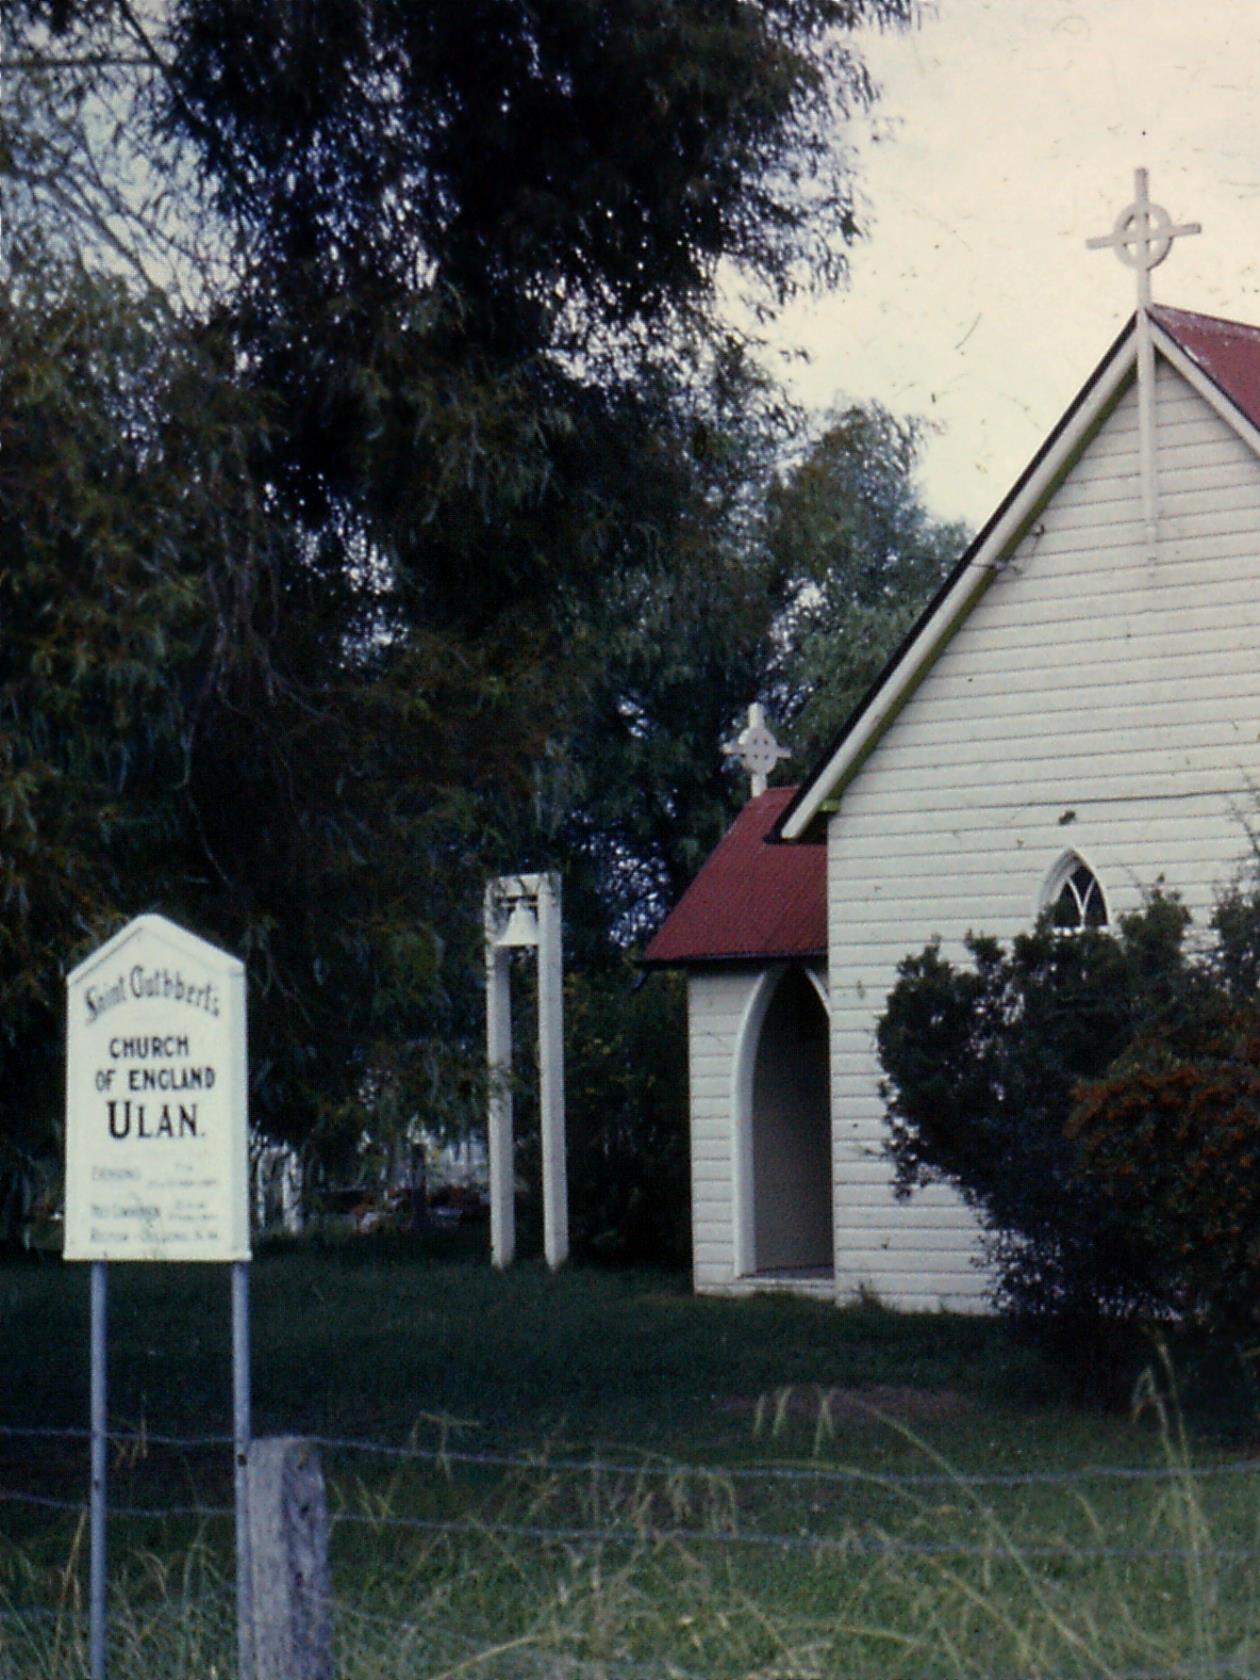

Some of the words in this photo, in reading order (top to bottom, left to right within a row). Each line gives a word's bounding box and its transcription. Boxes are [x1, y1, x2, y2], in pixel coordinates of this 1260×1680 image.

[110, 1036, 190, 1058] CHURCH
[96, 1069, 116, 1092] OF
[129, 1067, 215, 1091] ENGLAND
